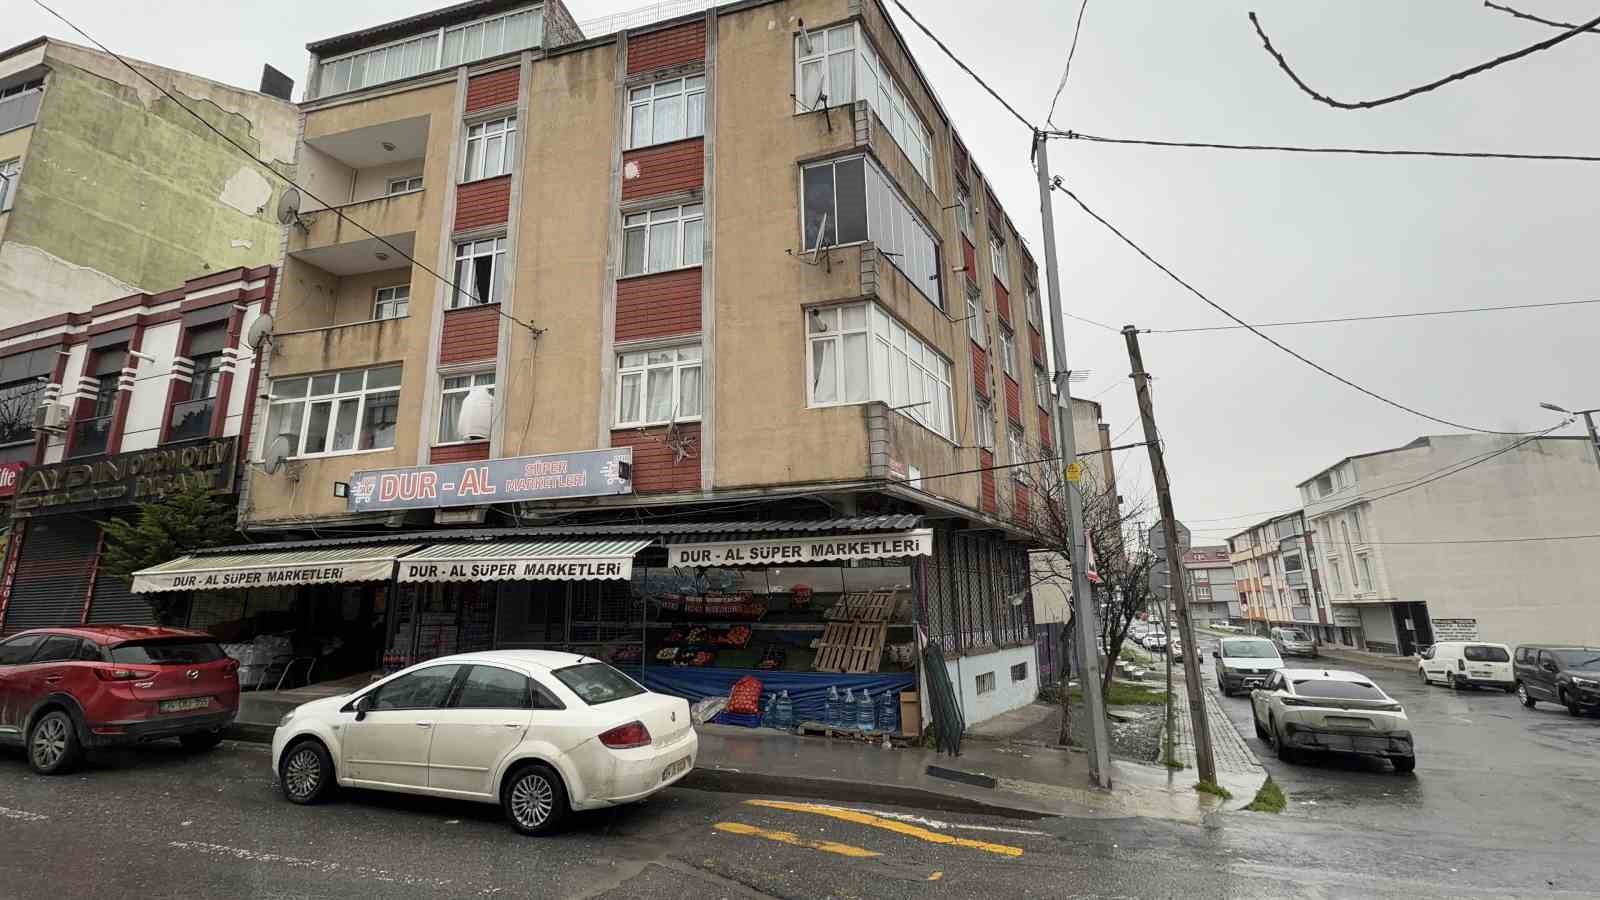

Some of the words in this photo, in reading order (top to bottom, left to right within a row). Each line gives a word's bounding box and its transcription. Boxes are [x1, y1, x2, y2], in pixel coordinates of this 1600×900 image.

[20, 459, 127, 494] AYDIN
[378, 471, 438, 505] DUR
[458, 467, 497, 496] AL
[680, 550, 711, 563] DUR
[725, 548, 744, 561] AL
[750, 545, 801, 560] SÜPER
[409, 565, 437, 577] DUR
[450, 564, 466, 577] AL
[471, 563, 516, 577] SÜPER
[173, 576, 196, 587] DUR
[205, 575, 219, 585] AL
[223, 572, 262, 585] SÜPER
